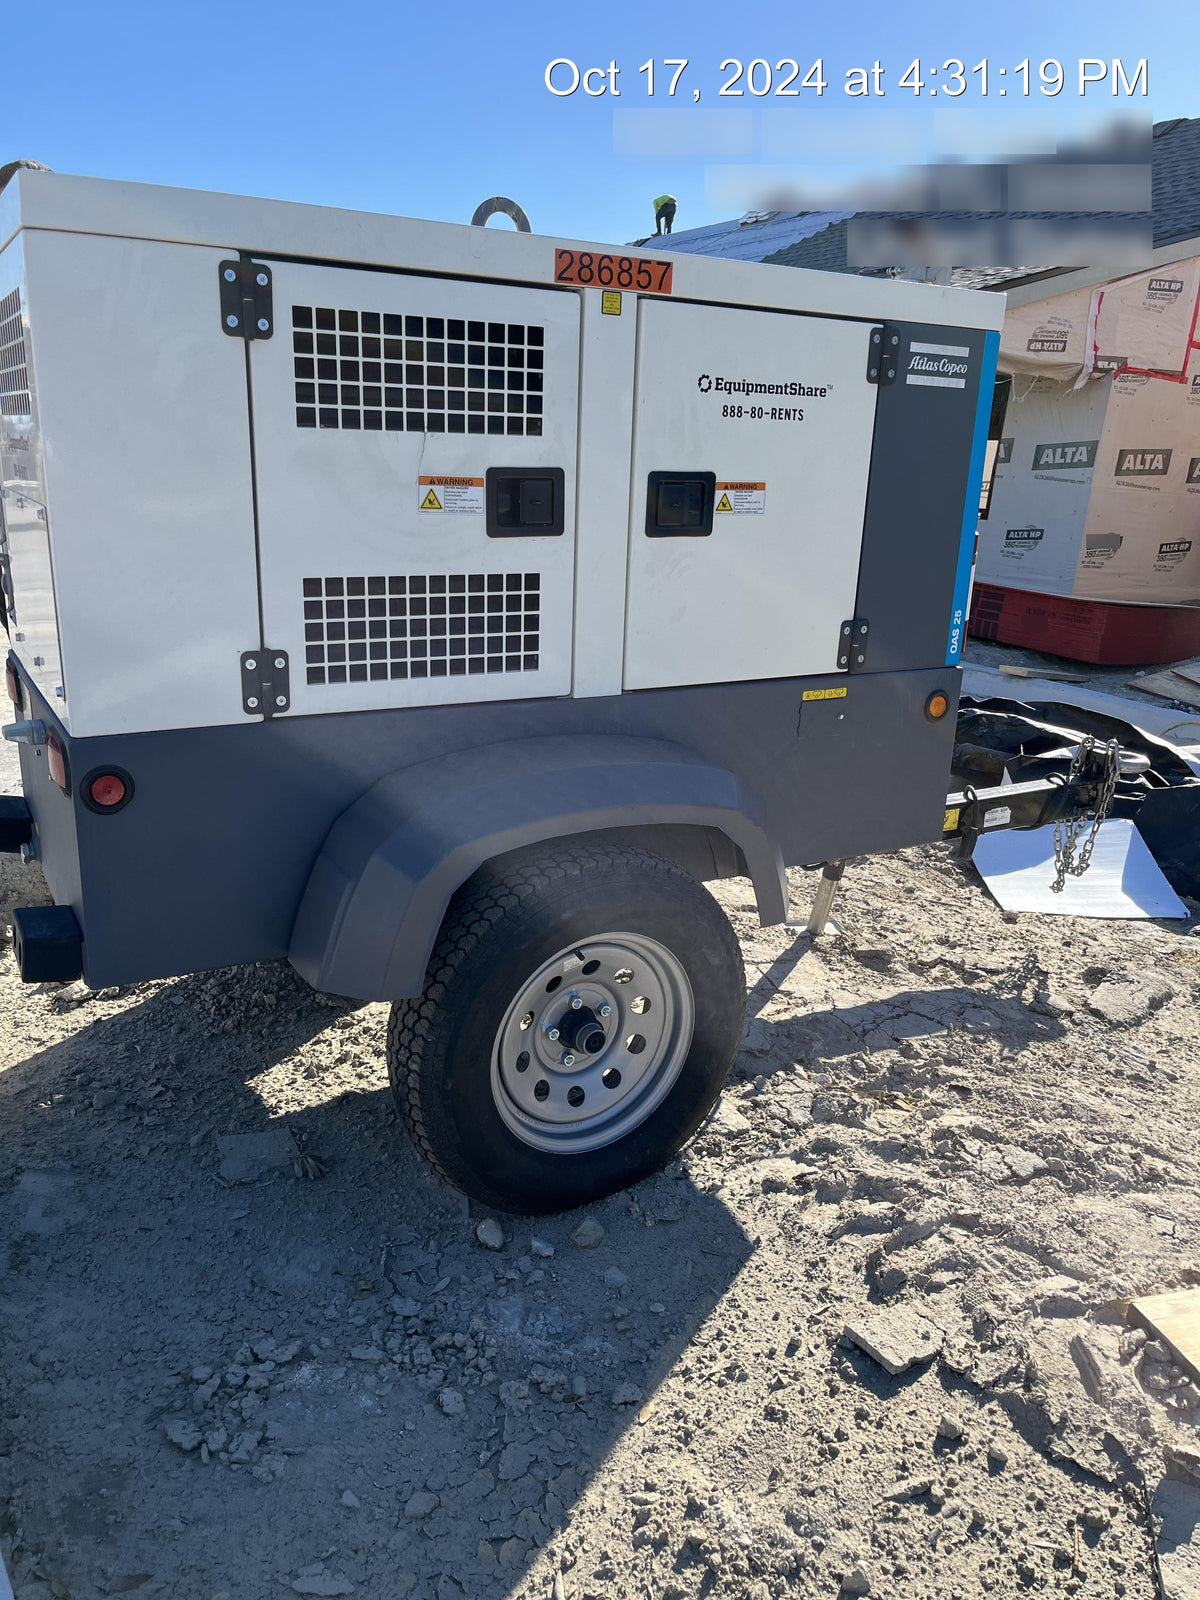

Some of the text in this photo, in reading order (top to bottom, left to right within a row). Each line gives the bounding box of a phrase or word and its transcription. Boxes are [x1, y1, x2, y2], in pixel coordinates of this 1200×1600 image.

[557, 250, 672, 291] 286857
[908, 355, 968, 376] Atlas Copco
[722, 404, 805, 421] 888-80-RENTS
[436, 478, 474, 487] WARNING
[730, 483, 758, 491] WARNING
[950, 610, 962, 654] QAS 25
